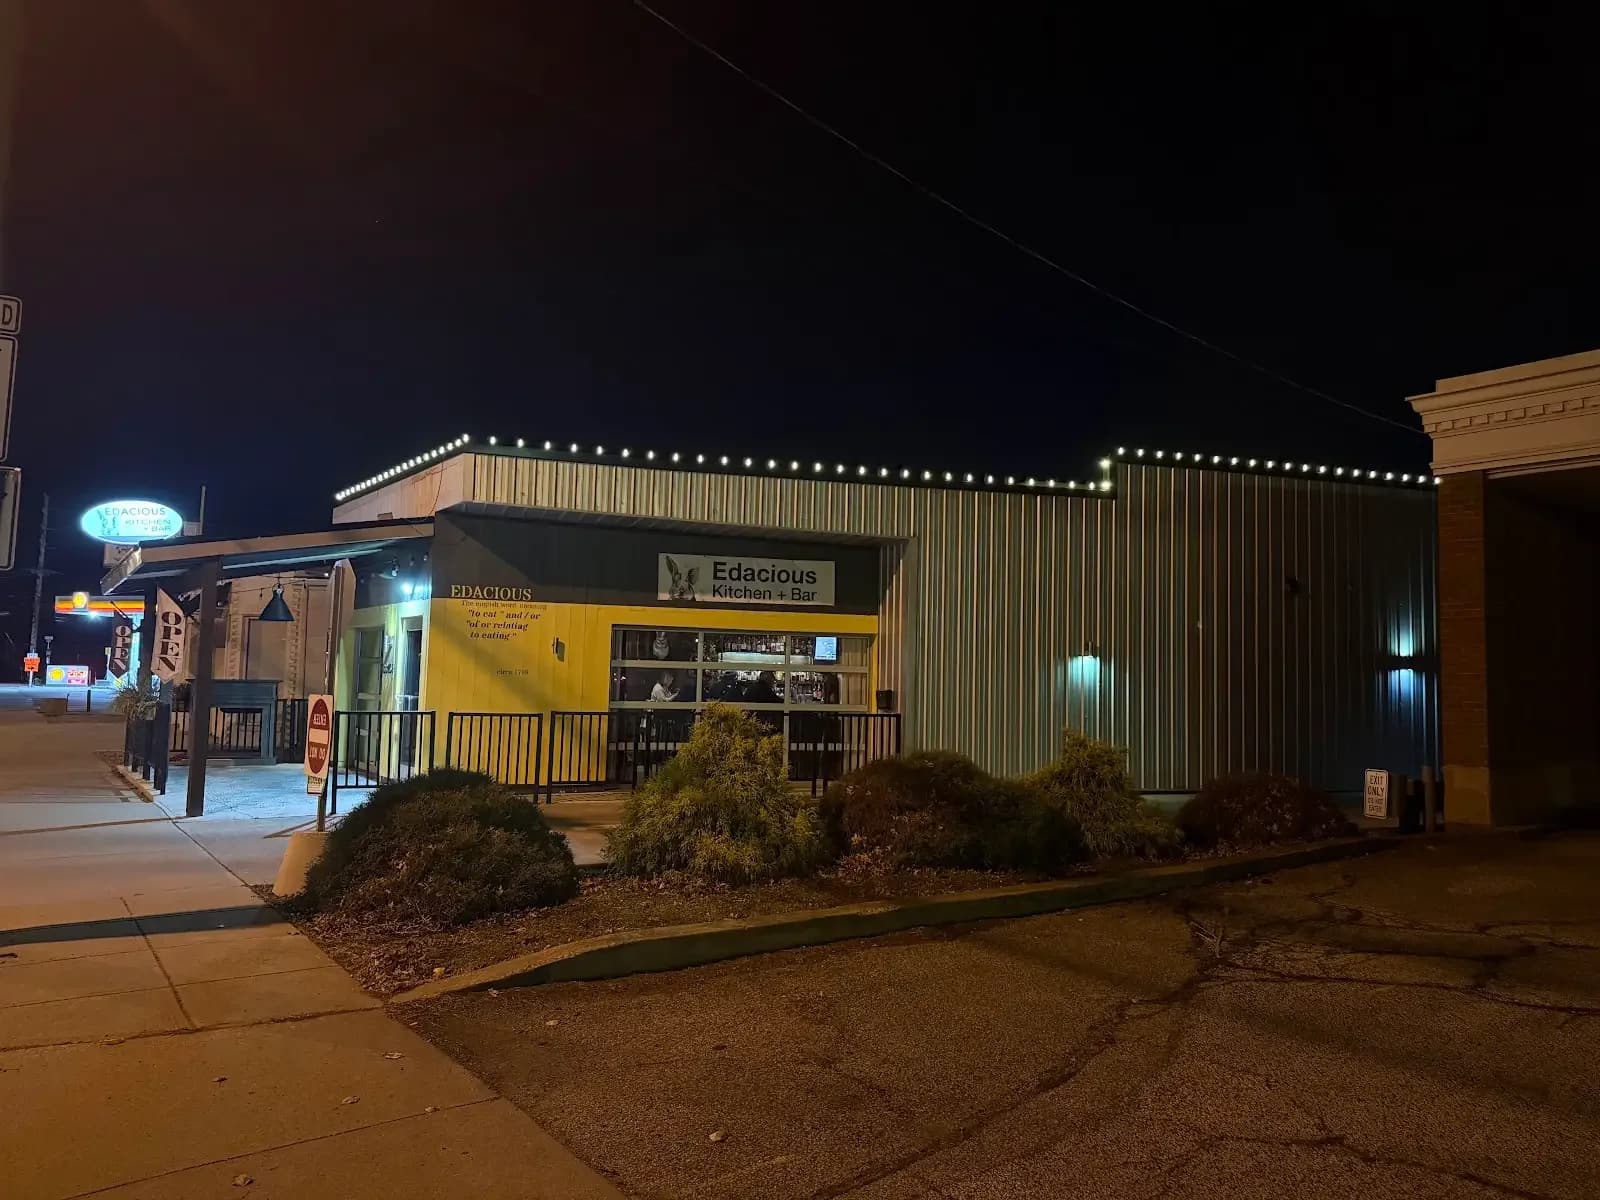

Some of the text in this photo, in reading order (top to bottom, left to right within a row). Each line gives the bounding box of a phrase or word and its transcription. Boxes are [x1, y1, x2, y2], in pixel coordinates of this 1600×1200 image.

[104, 507, 166, 516] EDACIOUS
[124, 518, 171, 527] KITCHEN
[712, 561, 817, 585] Edacious
[451, 584, 533, 601] EDACIOUS
[712, 584, 818, 602] Kitchen + Bar
[493, 621, 528, 631] relating
[113, 625, 132, 670] OPEN
[157, 611, 182, 672] OPEN
[1370, 775, 1385, 785] EXIT
[1367, 786, 1385, 797] ONLY
